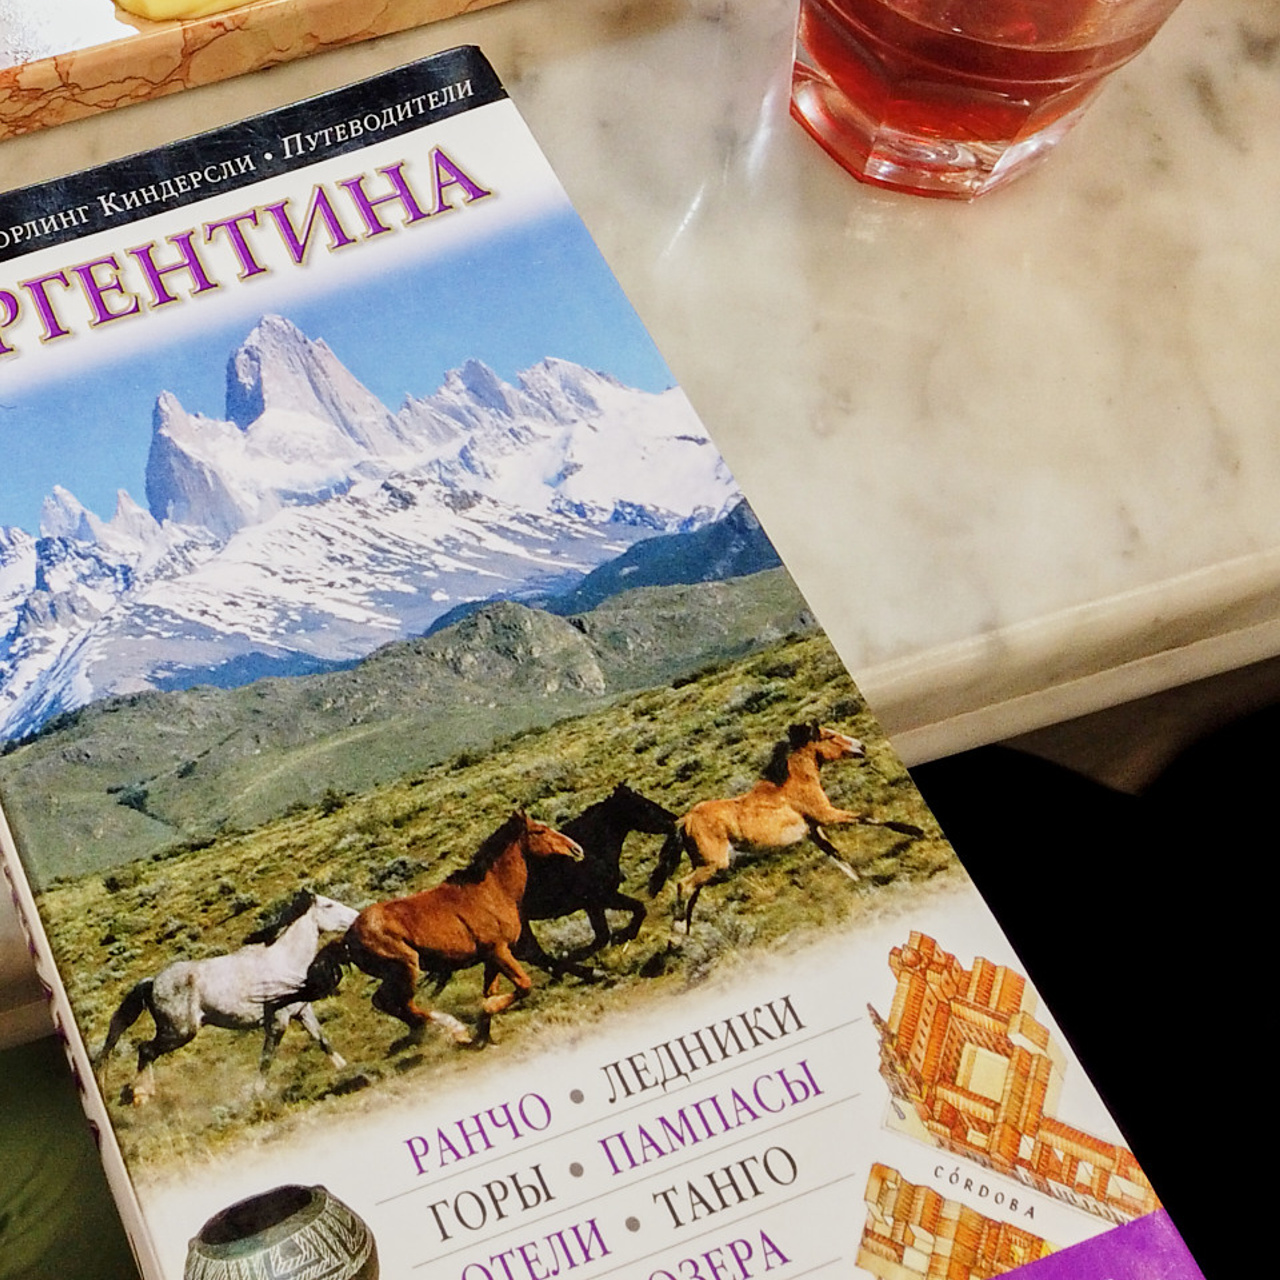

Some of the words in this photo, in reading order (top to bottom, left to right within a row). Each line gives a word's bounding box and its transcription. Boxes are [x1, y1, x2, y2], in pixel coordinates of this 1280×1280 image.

[402, 1092, 552, 1177] РАНЧО
[600, 994, 807, 1104] ЛЕДНИКИ
[427, 1164, 557, 1243] ГОРЫ
[597, 1059, 826, 1176] ПАМПАСЫ
[652, 1146, 799, 1229] ТАНГО
[933, 1165, 1036, 1220] CÓRDOBA
[648, 1228, 793, 1280] ЗЕРА
